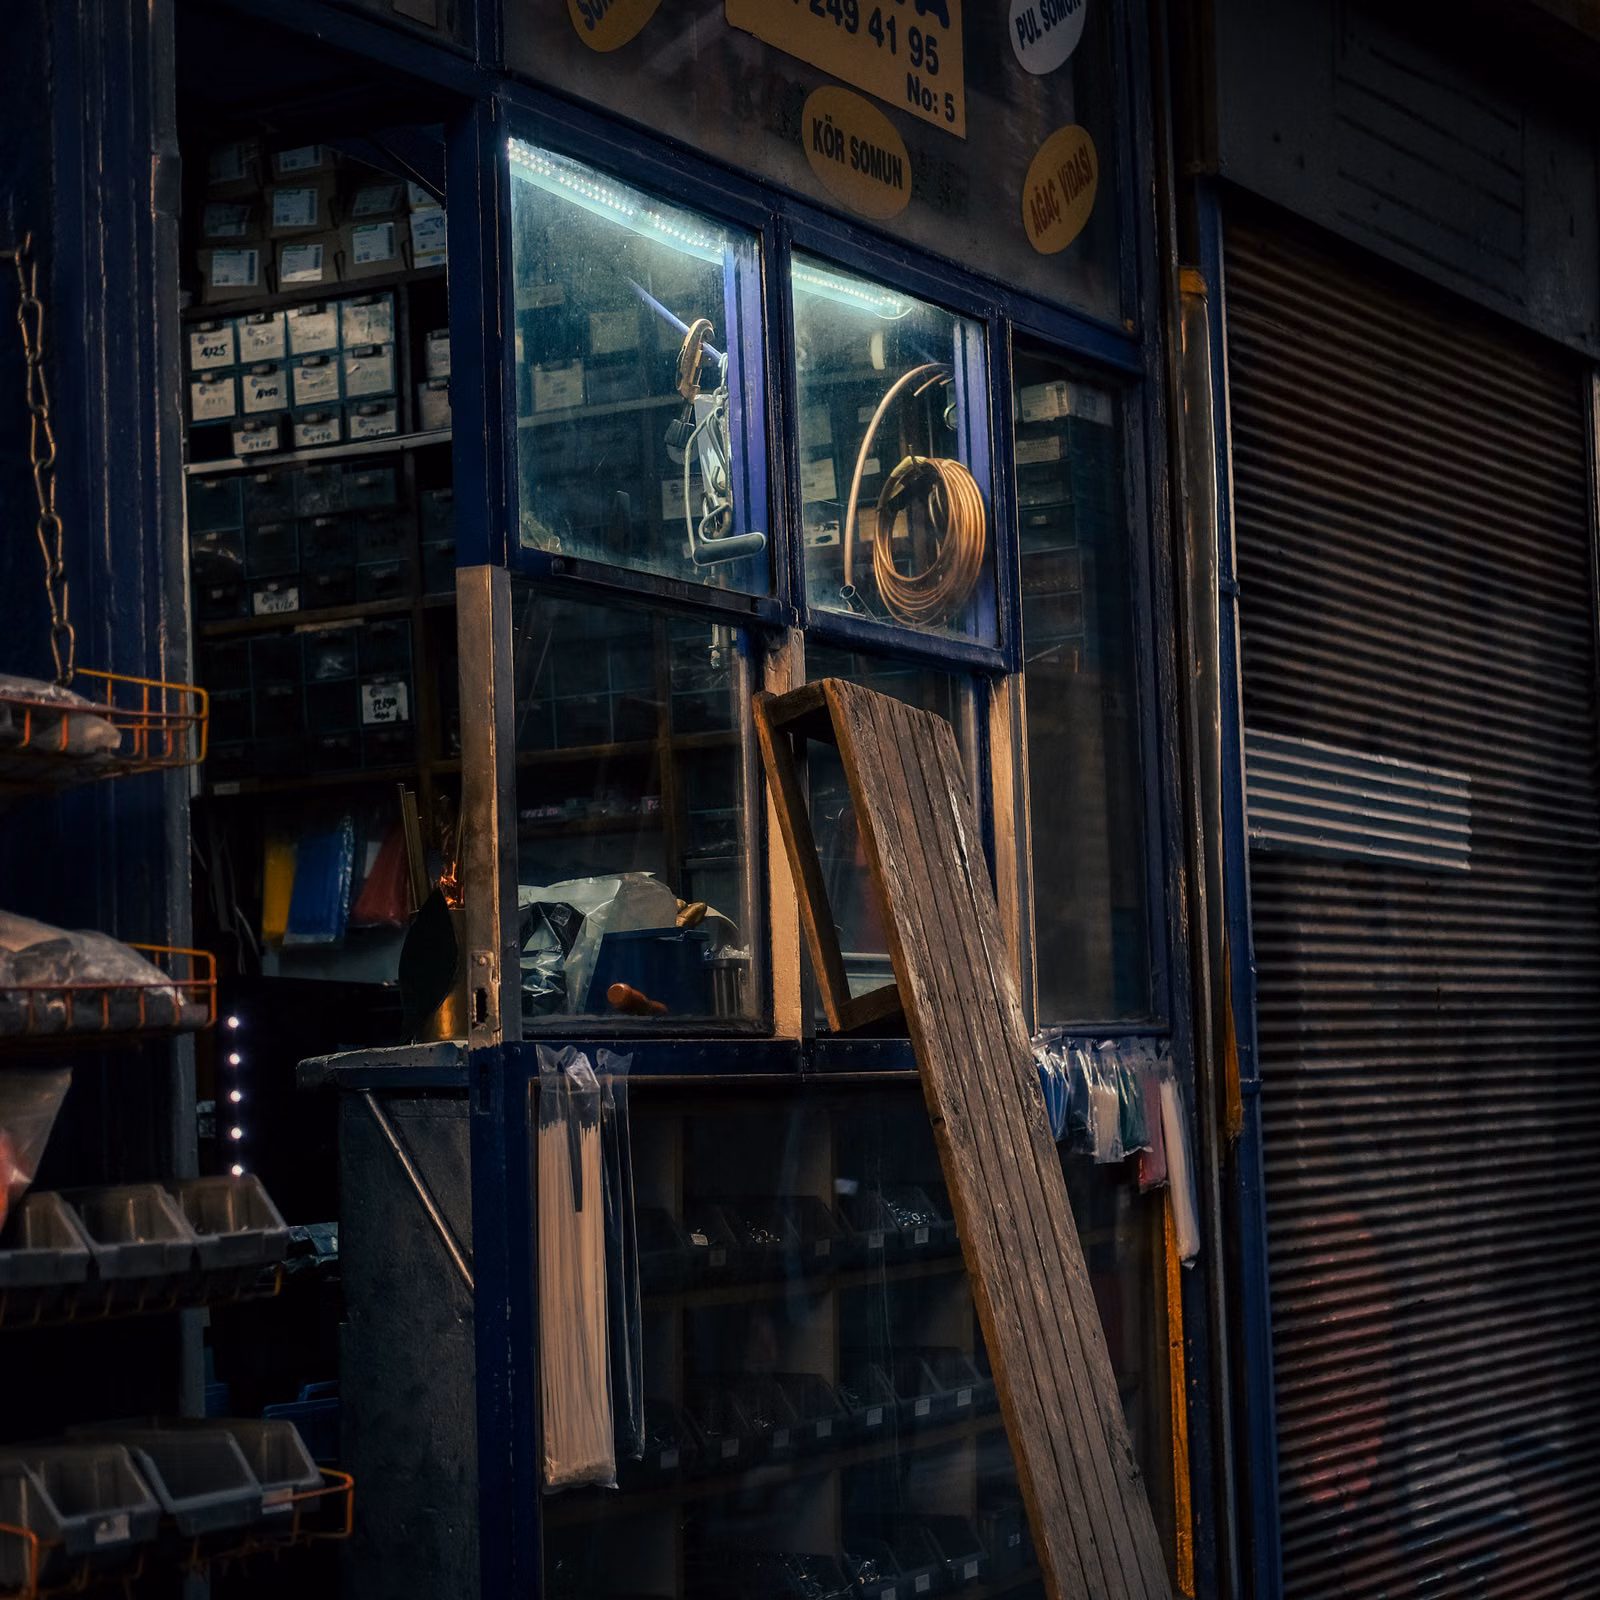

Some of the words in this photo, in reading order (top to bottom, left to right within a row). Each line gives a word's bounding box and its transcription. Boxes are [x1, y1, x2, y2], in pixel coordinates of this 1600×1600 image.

[868, 7, 897, 55] 41
[908, 26, 940, 75] 95
[1015, 7, 1042, 50] PUL
[906, 72, 939, 114] No:
[944, 92, 956, 123] 5
[812, 114, 845, 164] KÖR
[850, 135, 903, 190] SOMUN
[1030, 178, 1062, 237] AĞAÇ
